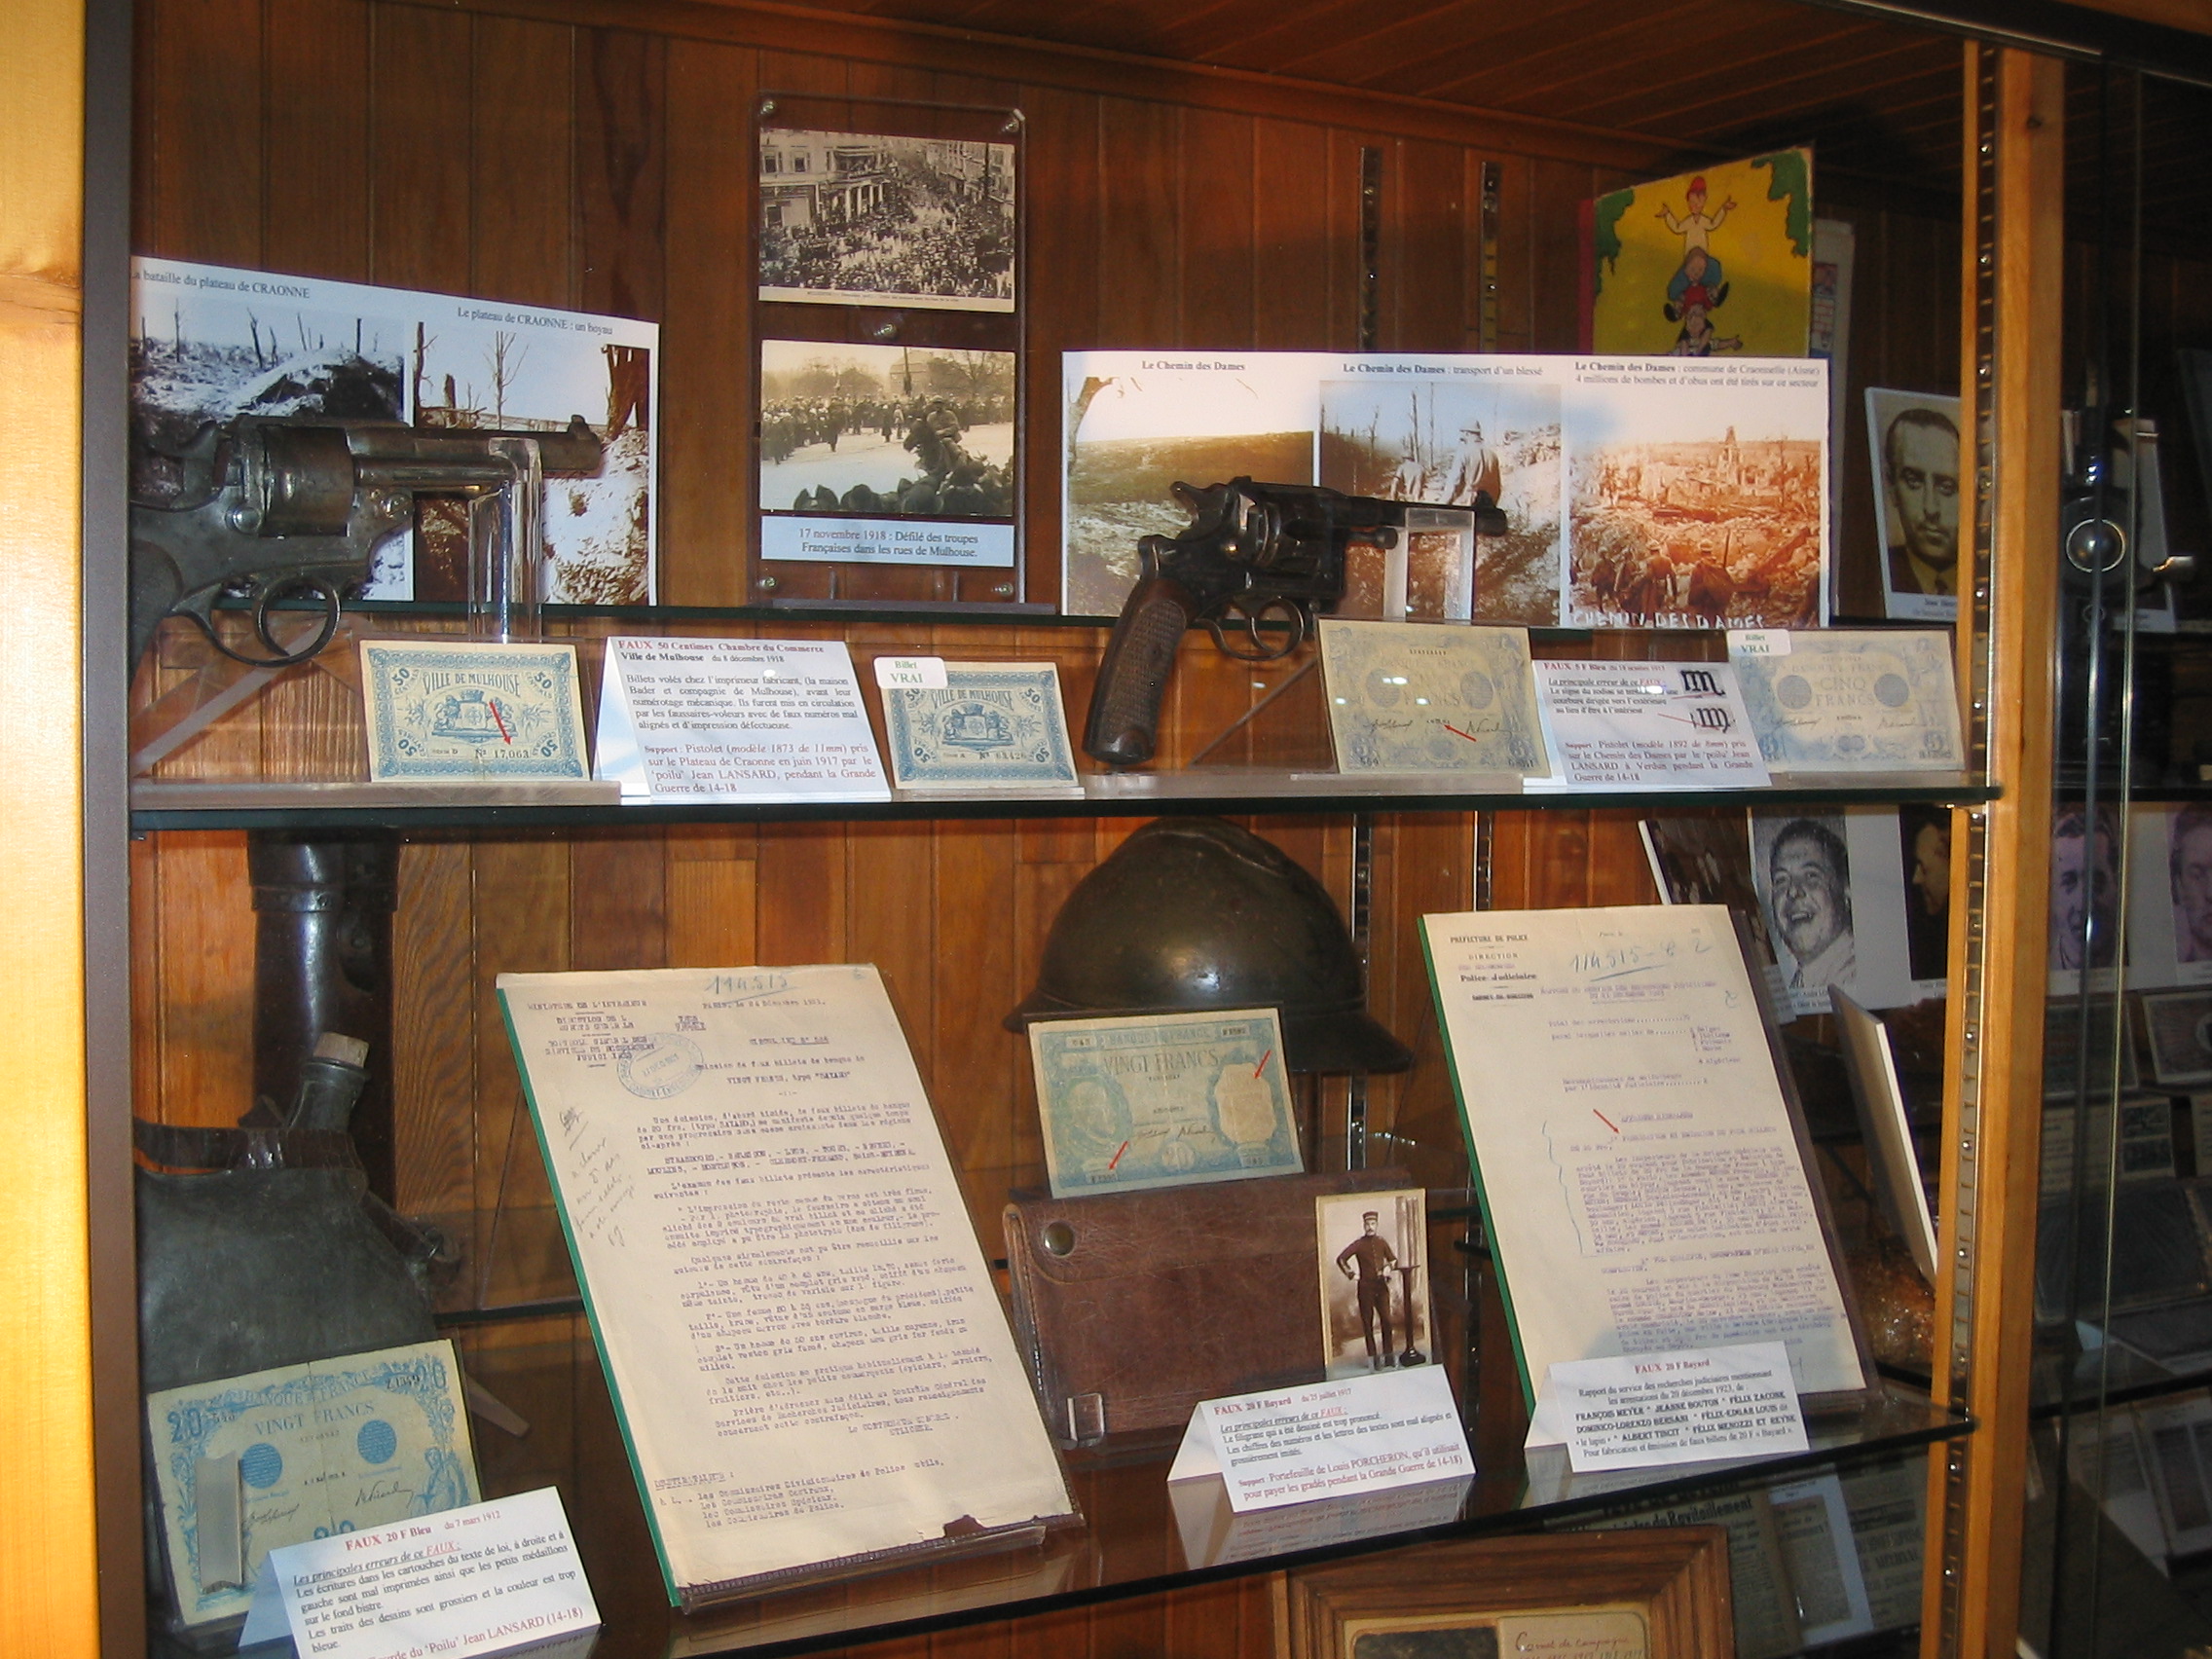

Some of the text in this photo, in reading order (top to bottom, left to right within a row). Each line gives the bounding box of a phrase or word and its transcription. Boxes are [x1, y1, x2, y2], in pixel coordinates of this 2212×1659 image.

[144, 270, 181, 283] bataille
[184, 275, 197, 285] du
[200, 276, 236, 289] plateau
[238, 280, 250, 291] de
[252, 281, 310, 297] CRAONNE
[458, 308, 469, 317] Le
[472, 310, 502, 321] plateau
[505, 313, 515, 322] de
[518, 315, 568, 329] CRAONNE
[588, 323, 612, 336] boyau
[1454, 366, 1492, 376] transport
[799, 528, 978, 545] 17 novembre 1918 Défilé des troupes
[802, 541, 851, 555] Françaises
[854, 543, 875, 553] dans
[878, 544, 891, 554] les
[915, 545, 927, 555] de
[930, 546, 977, 557] Mulhouse.
[618, 641, 824, 652] FAUX 50 Centimes Chambre du Commerce
[645, 652, 656, 661] de
[659, 652, 704, 661] Mulhouse
[730, 653, 764, 662] décembre
[391, 668, 410, 685] 50
[534, 672, 552, 689] 50
[891, 674, 923, 682] VRAI
[1821, 677, 1866, 691] CINQ
[423, 672, 521, 698] VILLE DE MULHOUSE
[631, 685, 655, 694] Bader
[680, 686, 726, 697] compagnie
[751, 686, 799, 697] Mulhouse),
[932, 689, 1014, 711] VILLE DE MULHOUSE
[1024, 688, 1040, 703] 50
[1816, 694, 1874, 707] FRANCS
[645, 744, 678, 756] Support
[726, 745, 766, 756] (modèle
[815, 745, 847, 756] 11mm)
[851, 745, 868, 756] pris
[793, 756, 812, 768] juin
[842, 759, 857, 768] par
[719, 769, 780, 779] LANSARD,
[785, 769, 823, 781] pendant
[709, 783, 737, 792] 14-18
[1103, 1049, 1219, 1076] VINGT FRANCS
[1636, 1358, 1710, 1374] FAUX Bayard
[1214, 1397, 1292, 1415] FAUX Bayard
[254, 1402, 375, 1436] VINGT FRANCS
[1270, 1452, 1411, 1482] Portefeuille de Louis PORCHERON,
[1369, 1464, 1424, 1478] Grande Guerre
[346, 1508, 501, 1551] FAUX 20 F Bleu du 7 mars 1912
[305, 1600, 383, 1625] sur le fond bistre.
[309, 1570, 576, 1639] Les traits des dessins sont grossiers et la couleur est trop
[411, 1645, 424, 1658] du
[424, 1636, 459, 1653] 'Poilu'
[463, 1634, 485, 1645] Jean
[487, 1614, 544, 1641] LANSARD
[547, 1606, 583, 1628] (14-18)
